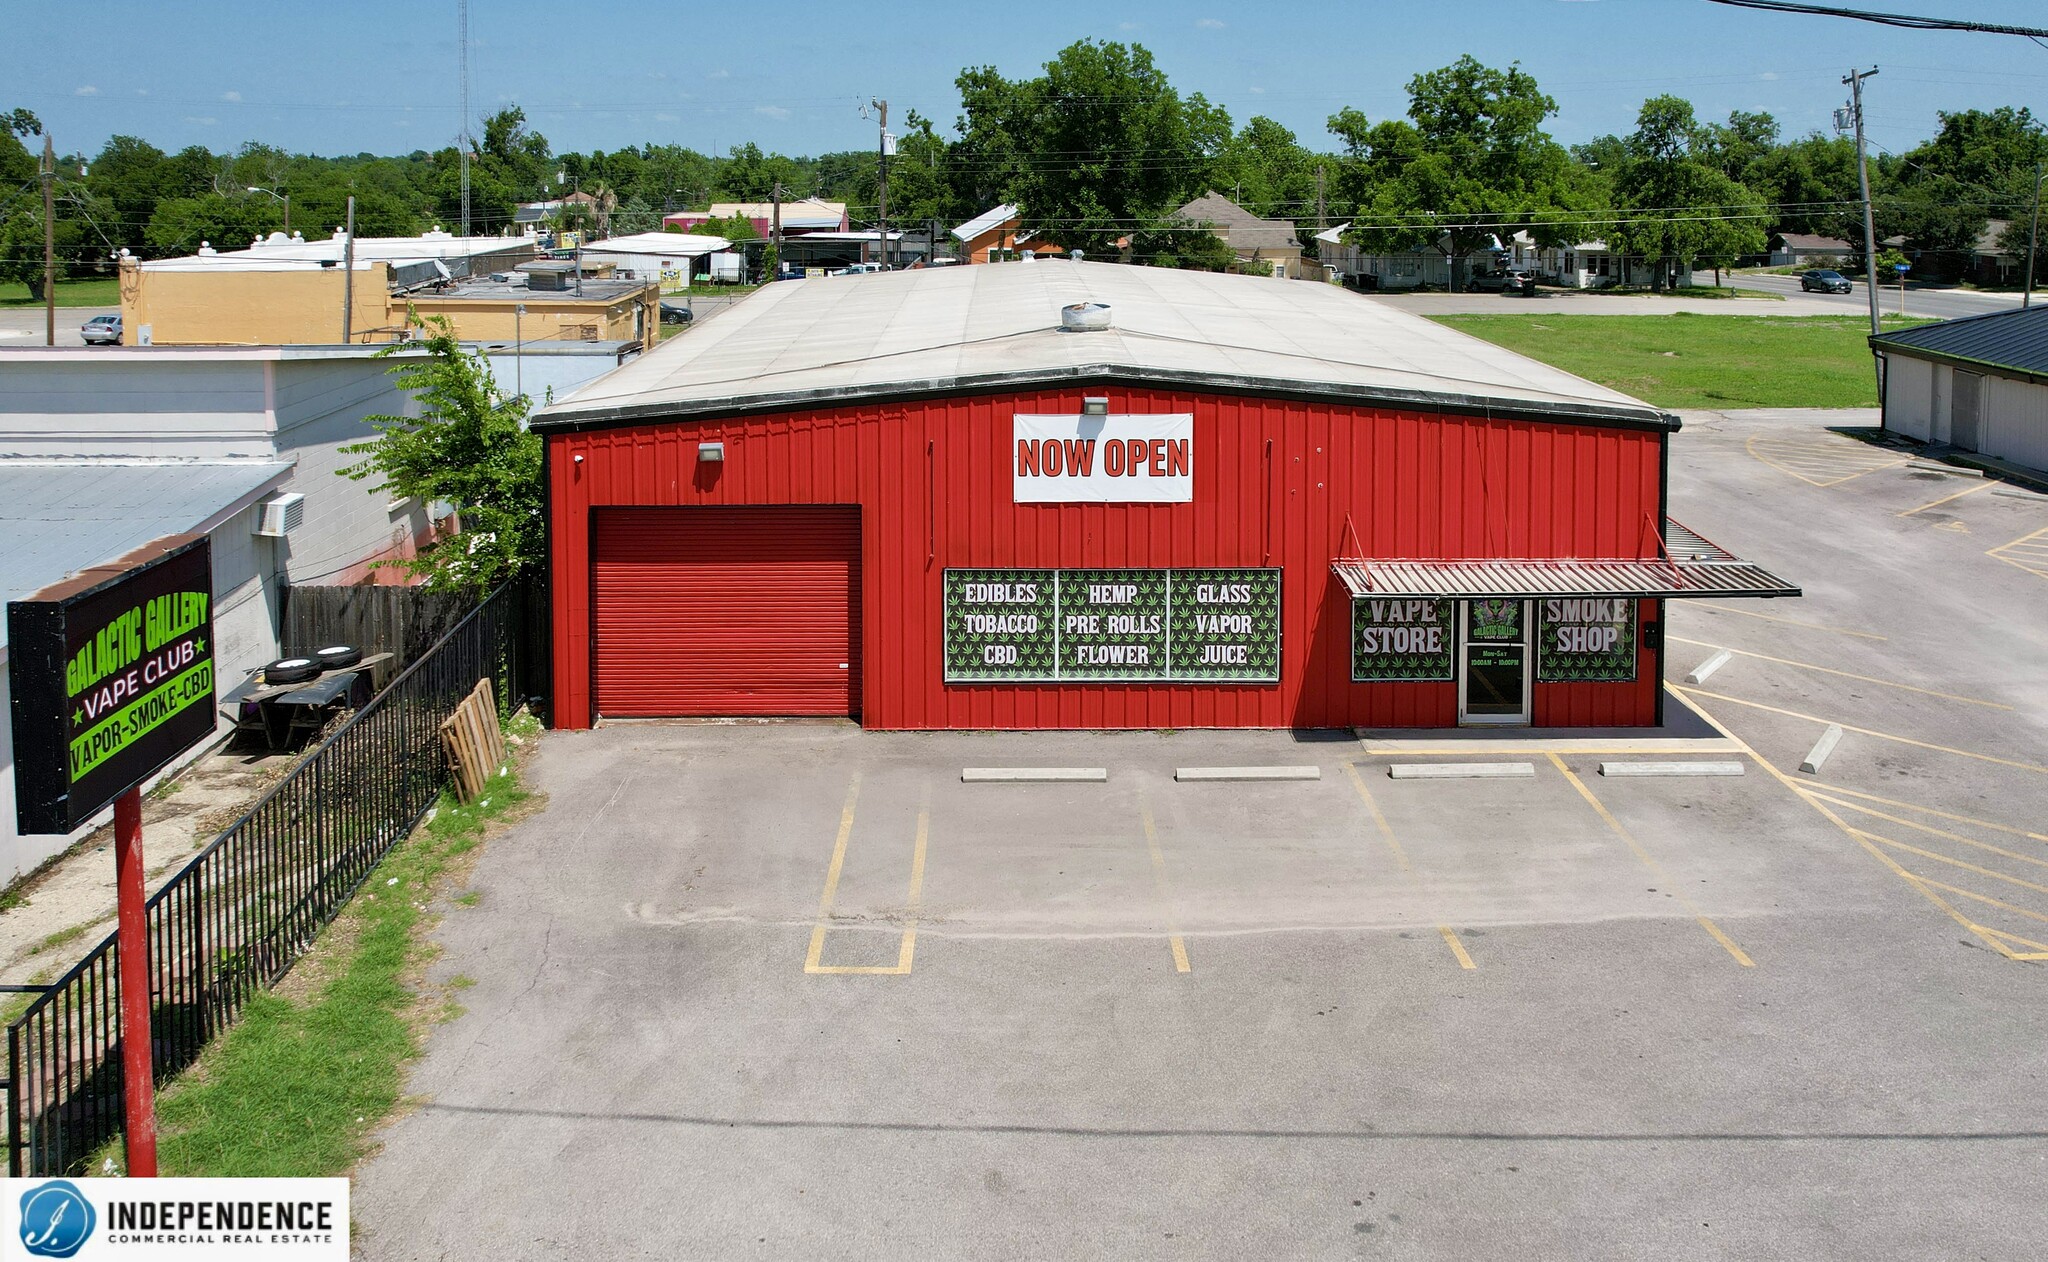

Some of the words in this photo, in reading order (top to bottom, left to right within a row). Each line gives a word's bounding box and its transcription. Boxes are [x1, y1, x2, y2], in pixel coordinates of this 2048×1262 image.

[1018, 439, 1096, 477] NOW
[1104, 439, 1189, 477] OPEN
[964, 583, 1037, 603] EDIBLES
[1089, 584, 1138, 604] HEMP
[1196, 584, 1251, 604] GLASS
[1370, 599, 1437, 623] VAPE
[1546, 598, 1629, 623] SMOKE
[964, 614, 1038, 634] TOBACCO
[1066, 615, 1100, 634] PRE
[1107, 615, 1161, 634] ROLLS
[1195, 614, 1252, 634] VAPOR
[1473, 625, 1497, 636] GALACTIC
[1497, 625, 1519, 636] GALLERY
[66, 605, 142, 698] GALACTIC
[145, 591, 208, 653] GALLERY
[1363, 626, 1443, 654] STORE
[1556, 626, 1618, 653] SHOP
[983, 645, 1017, 664] CBD
[1077, 645, 1149, 665] FLOWER
[1199, 645, 1248, 665] JUICE
[84, 670, 139, 720] VAPE
[144, 639, 195, 685] CLUB
[70, 666, 210, 775] VAPOR-SMOKE-CBD
